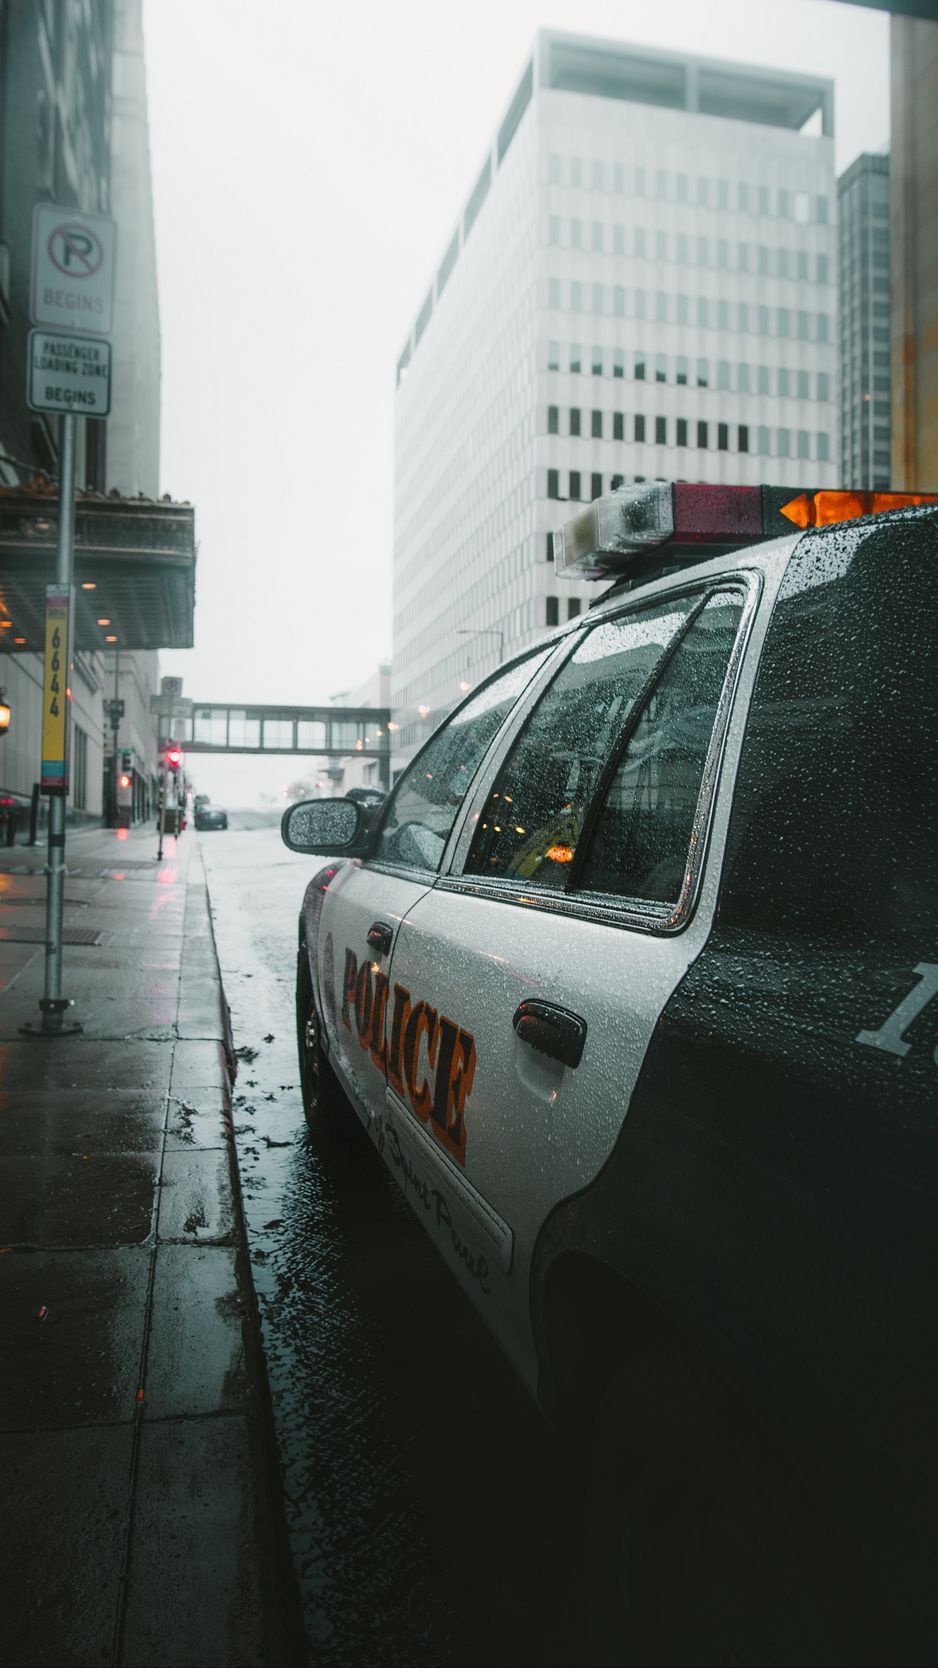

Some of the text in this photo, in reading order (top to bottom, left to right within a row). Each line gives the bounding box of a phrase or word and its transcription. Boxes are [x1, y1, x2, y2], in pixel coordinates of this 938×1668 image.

[43, 288, 104, 314] BEGINS
[43, 341, 100, 361] PASSENGER
[35, 356, 107, 379] LOADING ZONE
[45, 386, 96, 405] BEGINS
[855, 961, 938, 1067] 1
[342, 947, 477, 1168] POLICE
